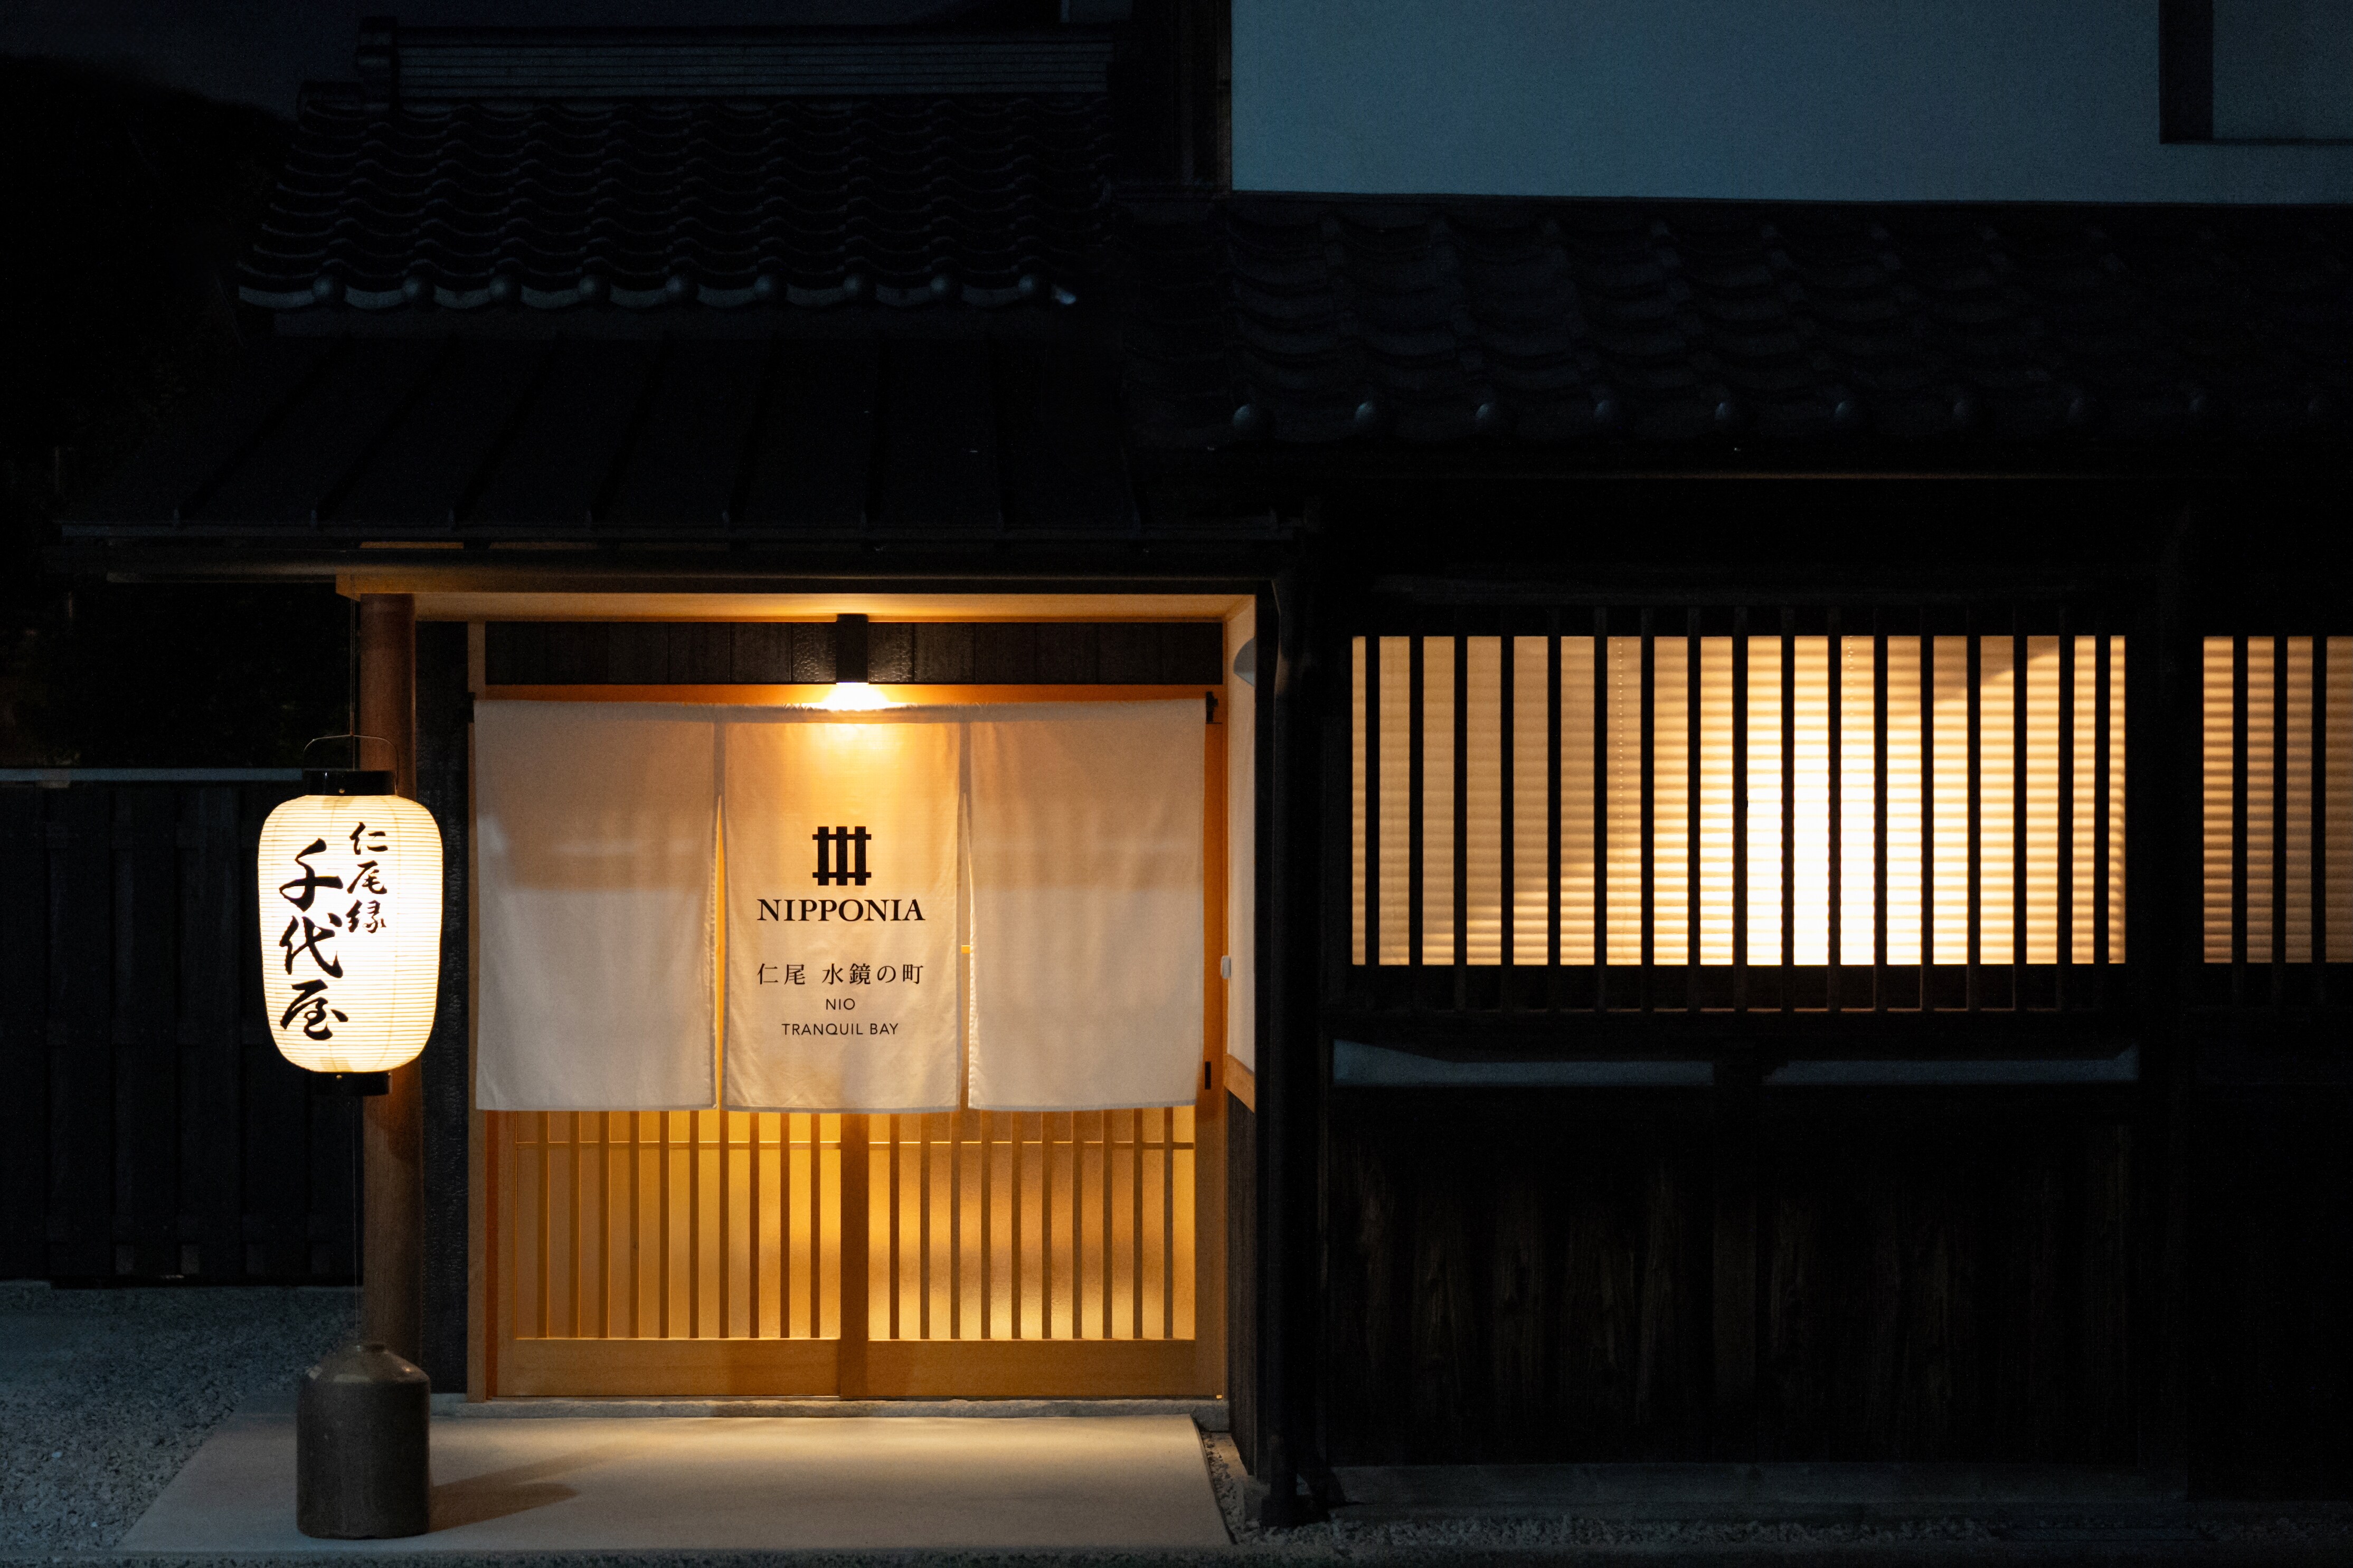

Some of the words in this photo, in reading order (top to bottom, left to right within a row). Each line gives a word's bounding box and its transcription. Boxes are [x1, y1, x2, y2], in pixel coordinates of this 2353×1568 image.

[757, 899, 925, 921] NIPPONIA
[279, 838, 349, 1041] 千代屋
[757, 963, 806, 985] 仁尾
[821, 963, 924, 985] 水鏡の町
[825, 998, 855, 1010] NIO
[781, 1023, 863, 1035] TRANQUIL
[870, 1023, 899, 1035] BAY
